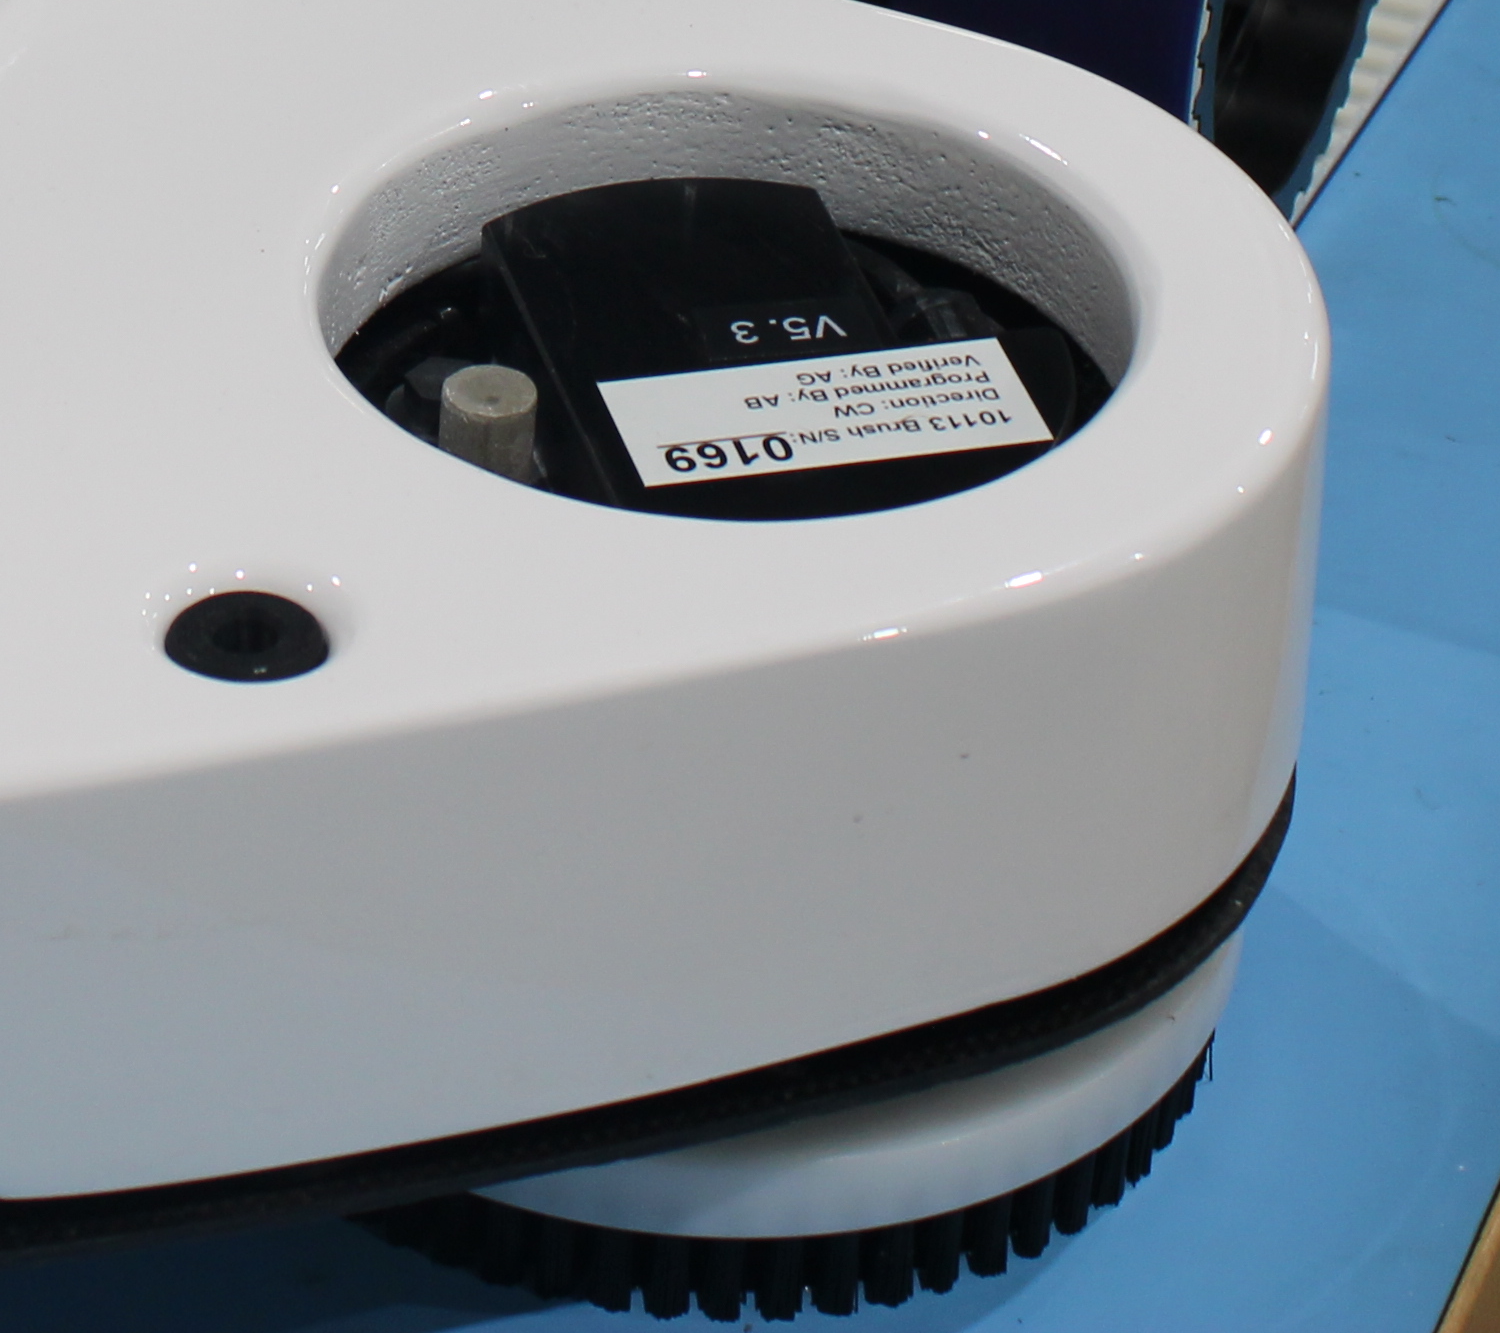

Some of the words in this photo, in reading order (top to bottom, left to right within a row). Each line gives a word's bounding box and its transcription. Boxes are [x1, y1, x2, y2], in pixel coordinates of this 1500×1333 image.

[840, 362, 882, 380] By:
[888, 353, 981, 376] Verified
[795, 370, 832, 386] AG
[834, 370, 991, 398] Programmed
[743, 393, 780, 411] AB
[788, 387, 831, 405] By:
[882, 387, 1001, 410] Direction:
[833, 401, 876, 420] CW
[928, 408, 1013, 431] 10113
[788, 427, 842, 446] S/N:
[849, 416, 922, 439] Brush
[663, 435, 795, 473] 0169
